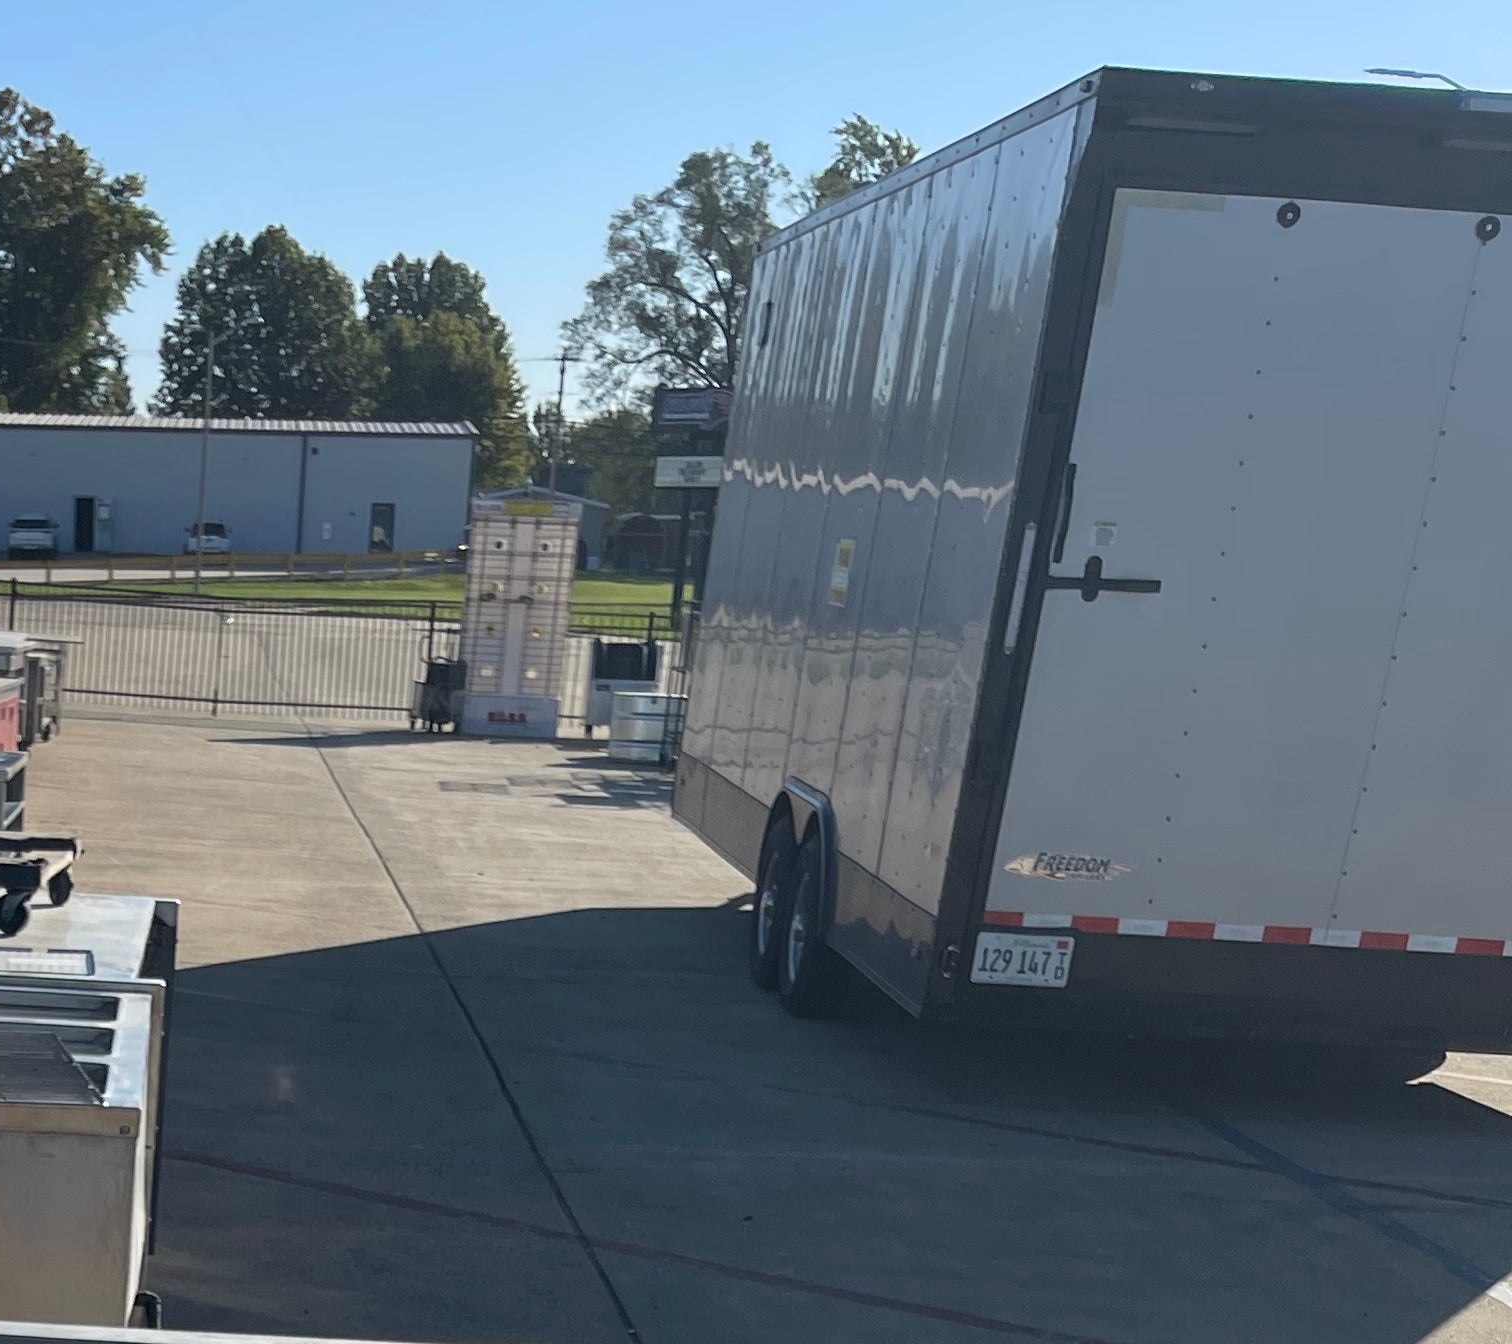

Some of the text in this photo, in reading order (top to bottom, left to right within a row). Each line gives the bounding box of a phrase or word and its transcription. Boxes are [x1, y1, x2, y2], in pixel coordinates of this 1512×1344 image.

[1033, 852, 1111, 873] FREEDOM
[978, 946, 1014, 974] 129
[1016, 950, 1052, 977] 147
